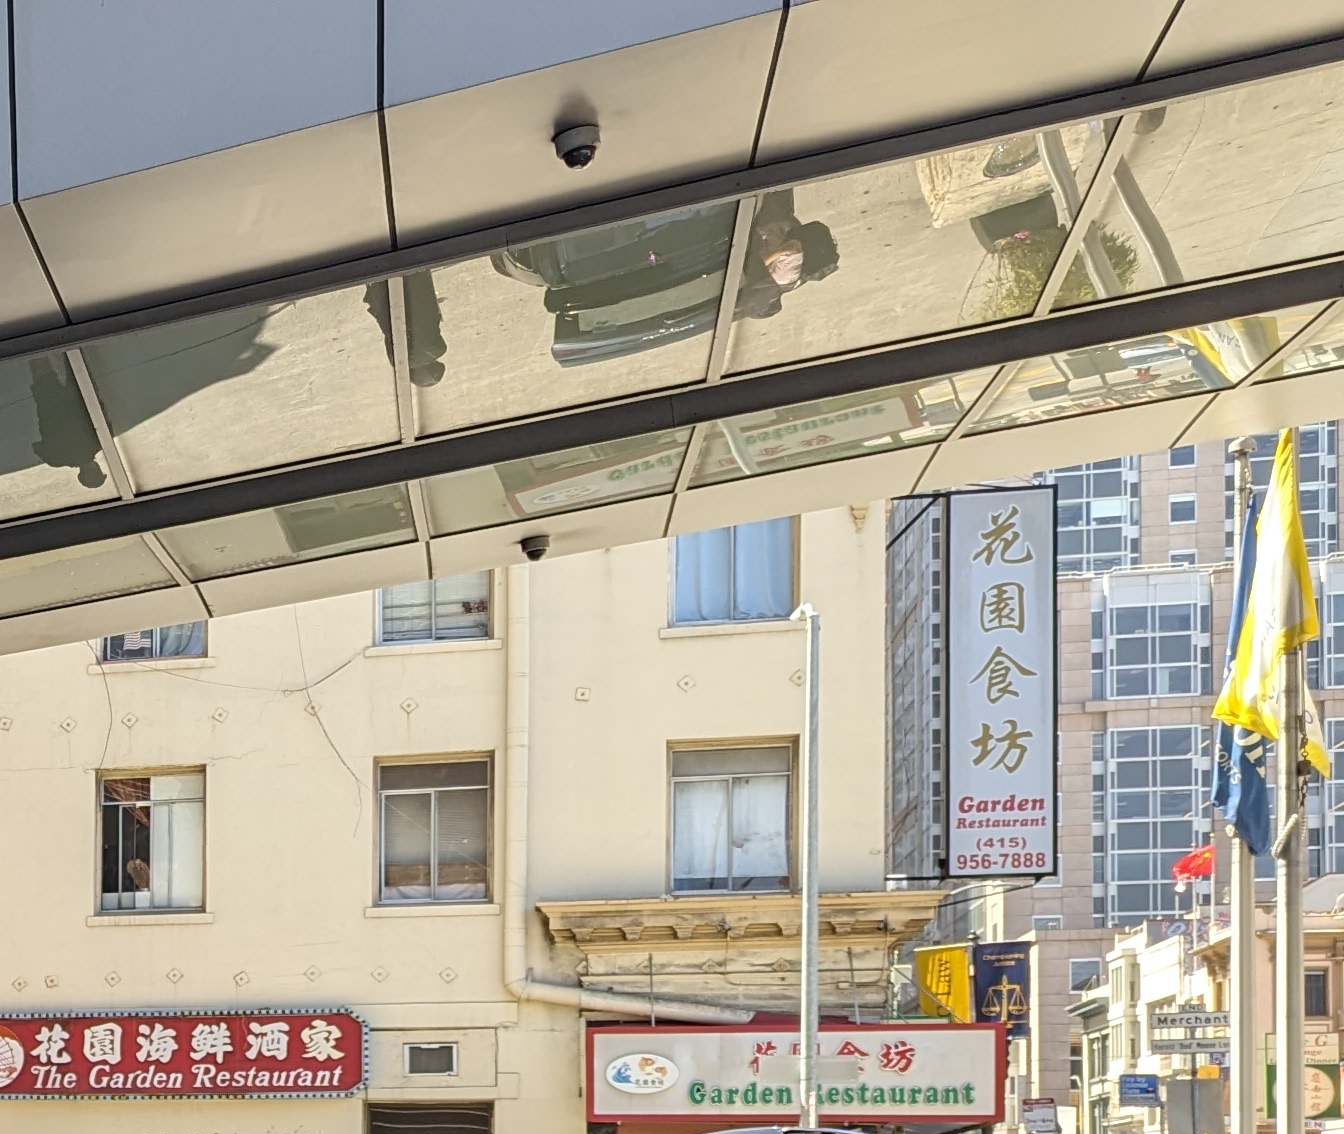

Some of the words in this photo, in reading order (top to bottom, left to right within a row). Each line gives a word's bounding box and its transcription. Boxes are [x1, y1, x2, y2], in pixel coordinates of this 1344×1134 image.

[969, 505, 1039, 775] 花園食坊
[958, 795, 1046, 814] Garden
[955, 815, 1048, 830] Restaurant
[975, 837, 1028, 852] (415)
[955, 852, 1047, 870] 956-7888
[1157, 1015, 1229, 1026] Merchant
[30, 1019, 346, 1065] 花園海鮮酒家
[30, 1064, 78, 1089] The
[88, 1063, 184, 1090] Garden
[191, 1062, 343, 1089] Restaurant
[688, 1080, 791, 1106] Garden
